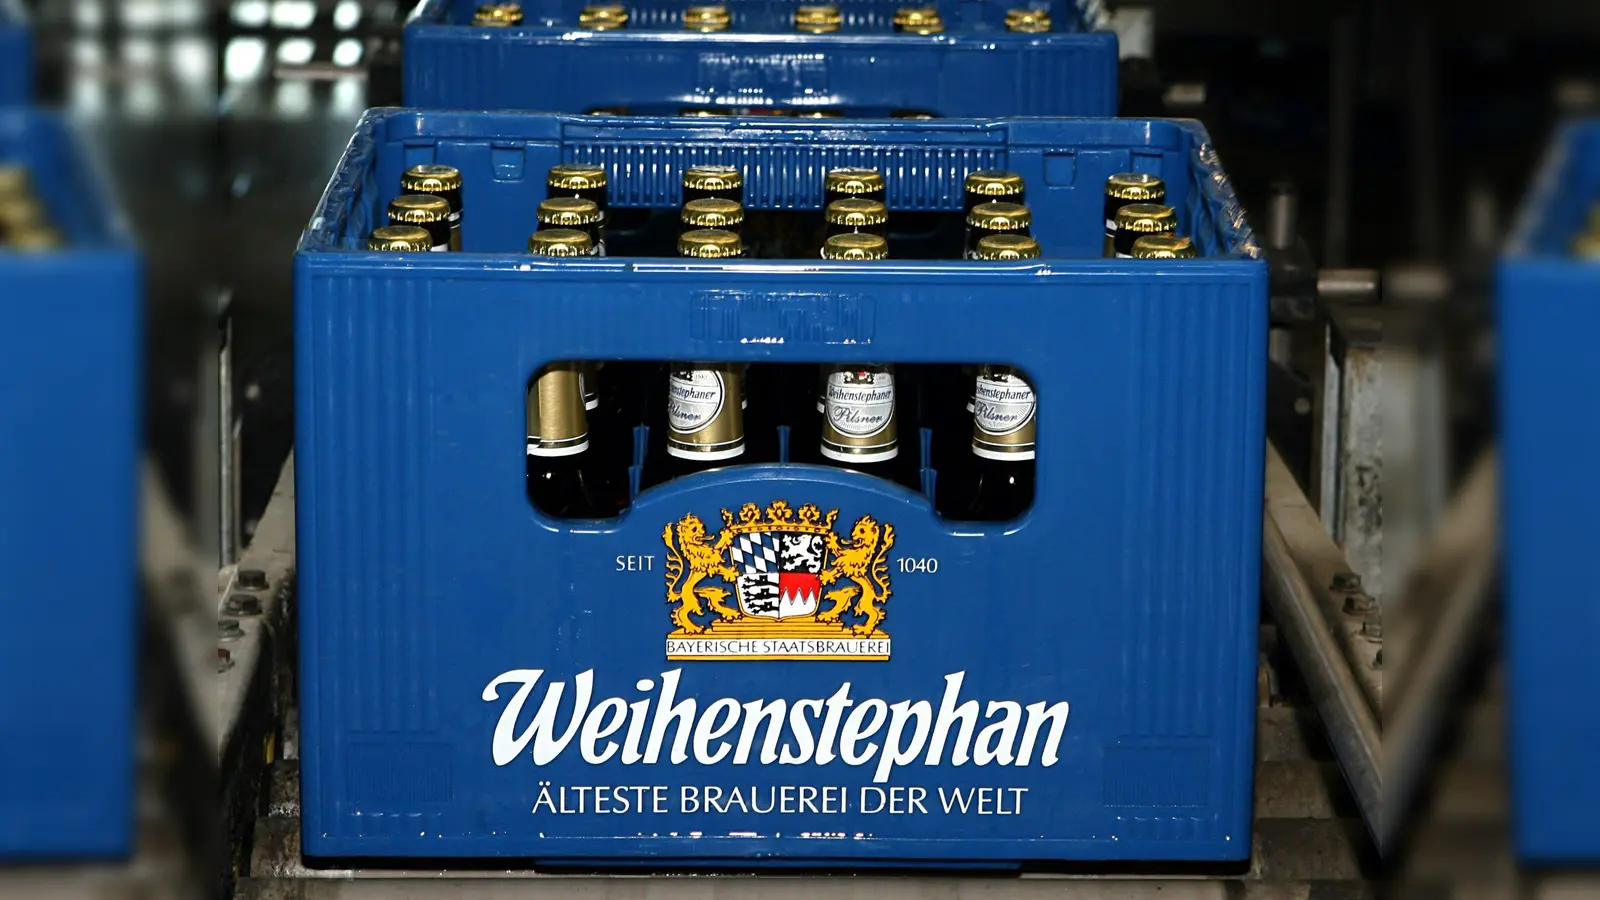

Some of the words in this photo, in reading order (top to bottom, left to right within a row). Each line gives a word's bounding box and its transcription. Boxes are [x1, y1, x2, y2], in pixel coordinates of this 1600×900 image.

[833, 405, 882, 423] Pilsner
[616, 555, 655, 571] SEIT
[896, 557, 938, 574] 1040
[666, 640, 758, 653] BAYERISCHE
[763, 640, 890, 654] STAATSBRAUEREI
[482, 668, 1069, 783] Weihenstephan
[531, 781, 668, 814] ÄLTESTE
[681, 785, 848, 814] BRAUEREI
[860, 786, 928, 814] DER
[937, 787, 1029, 815] WELT
